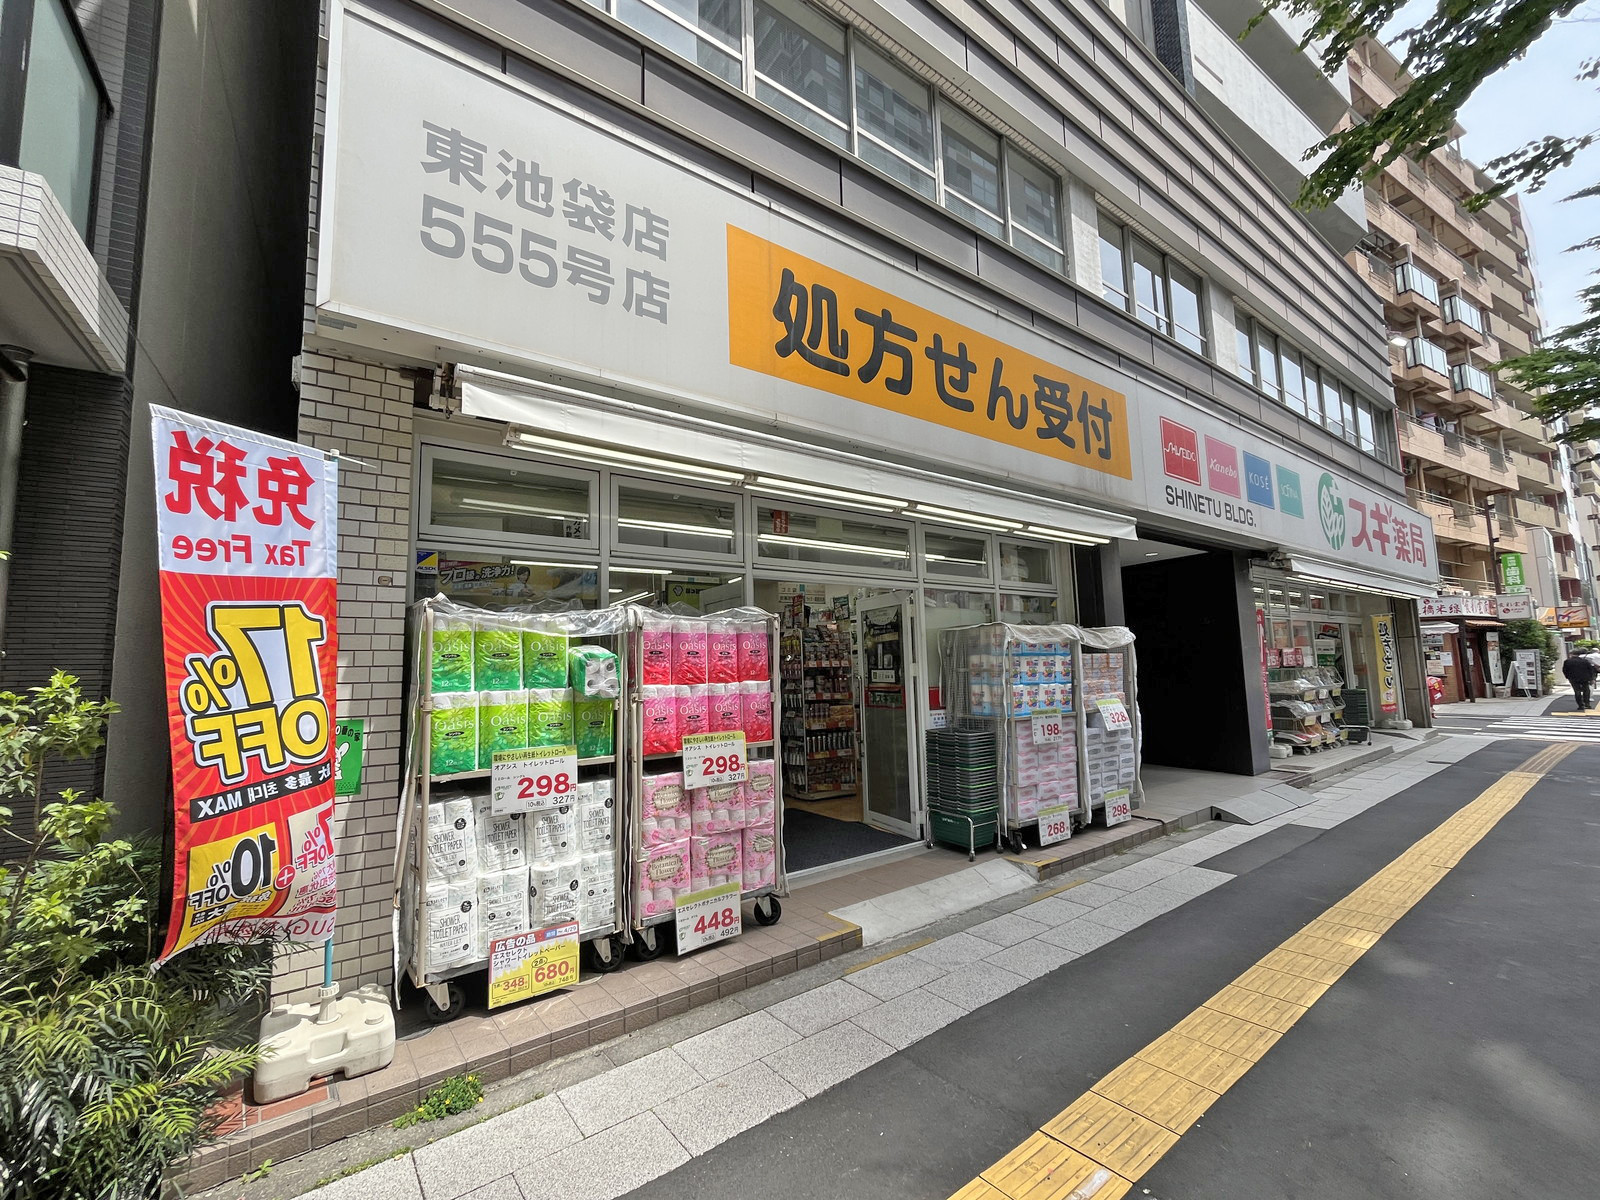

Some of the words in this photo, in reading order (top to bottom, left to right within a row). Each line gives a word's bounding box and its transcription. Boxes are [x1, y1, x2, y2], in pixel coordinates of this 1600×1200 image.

[420, 120, 669, 262] 東池袋店
[420, 194, 670, 325] 555号店
[772, 267, 1113, 461] 処方せん受付
[1209, 458, 1237, 479] Kanebo
[1165, 484, 1221, 518] SHINETU
[1224, 502, 1257, 528] BLDG.
[1348, 497, 1427, 568] スギ薬局
[530, 640, 566, 652] Oasis
[679, 641, 706, 651] Oasis
[713, 641, 737, 651] Oasis
[742, 640, 767, 650] Oasis
[645, 705, 675, 718] Oasis
[679, 704, 707, 715] Oasis
[714, 702, 739, 713] Oasis
[490, 714, 526, 727] Oasis
[537, 711, 572, 723] Oasis
[434, 718, 474, 731] Oasis
[705, 741, 736, 750] トイレットロール
[494, 763, 518, 771] オアシス
[523, 757, 565, 768] トイレットロール
[702, 754, 746, 777] 298円
[727, 772, 745, 782] 327円
[517, 772, 577, 800] 298円
[552, 794, 575, 805] 327円
[541, 814, 559, 827] SHOWER
[588, 808, 605, 820] SHOWER
[492, 820, 511, 834] SHOWER
[553, 821, 566, 833] PAPER
[597, 815, 610, 828] PAPER
[433, 830, 456, 845] SHOWER
[504, 827, 518, 841] PAPER
[446, 838, 464, 852] PAPER
[651, 859, 680, 871] Botanical
[655, 866, 676, 876] Flower
[439, 914, 461, 928] SHOWER
[694, 907, 740, 934] 448円
[452, 921, 468, 935] PAPER
[720, 926, 739, 937] 492円
[495, 934, 536, 952] 広告の品
[493, 948, 528, 960] エスセレクト
[493, 944, 566, 968] シャワートイレットペーパー
[534, 960, 575, 983] 680円
